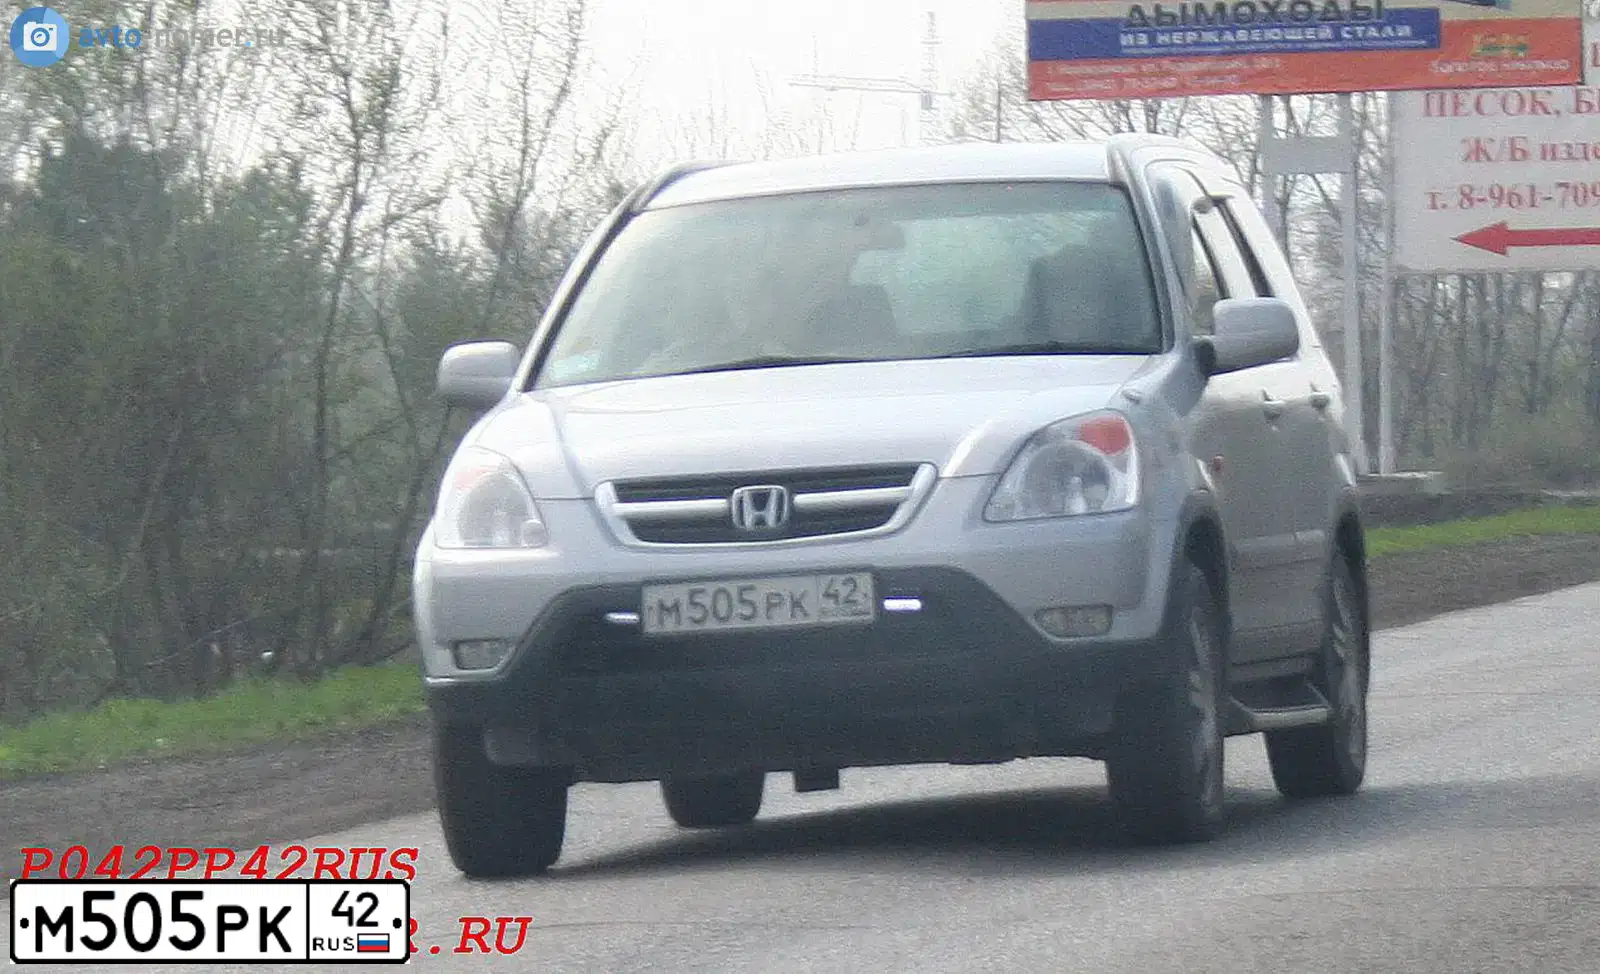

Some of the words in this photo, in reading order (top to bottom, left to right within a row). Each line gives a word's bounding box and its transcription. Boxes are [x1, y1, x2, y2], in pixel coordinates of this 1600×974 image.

[1126, 0, 1383, 27] ДЫМОХОДЫ
[1119, 33, 1149, 46] ИЗ
[1156, 25, 1334, 45] НЕРЖАВЕЮЩЕЙ
[1340, 25, 1412, 39] СТАЛИ
[1424, 90, 1561, 118] ПЕСОК,
[1572, 87, 1600, 114] Б
[1426, 191, 1448, 210] т.
[821, 576, 858, 606] 42
